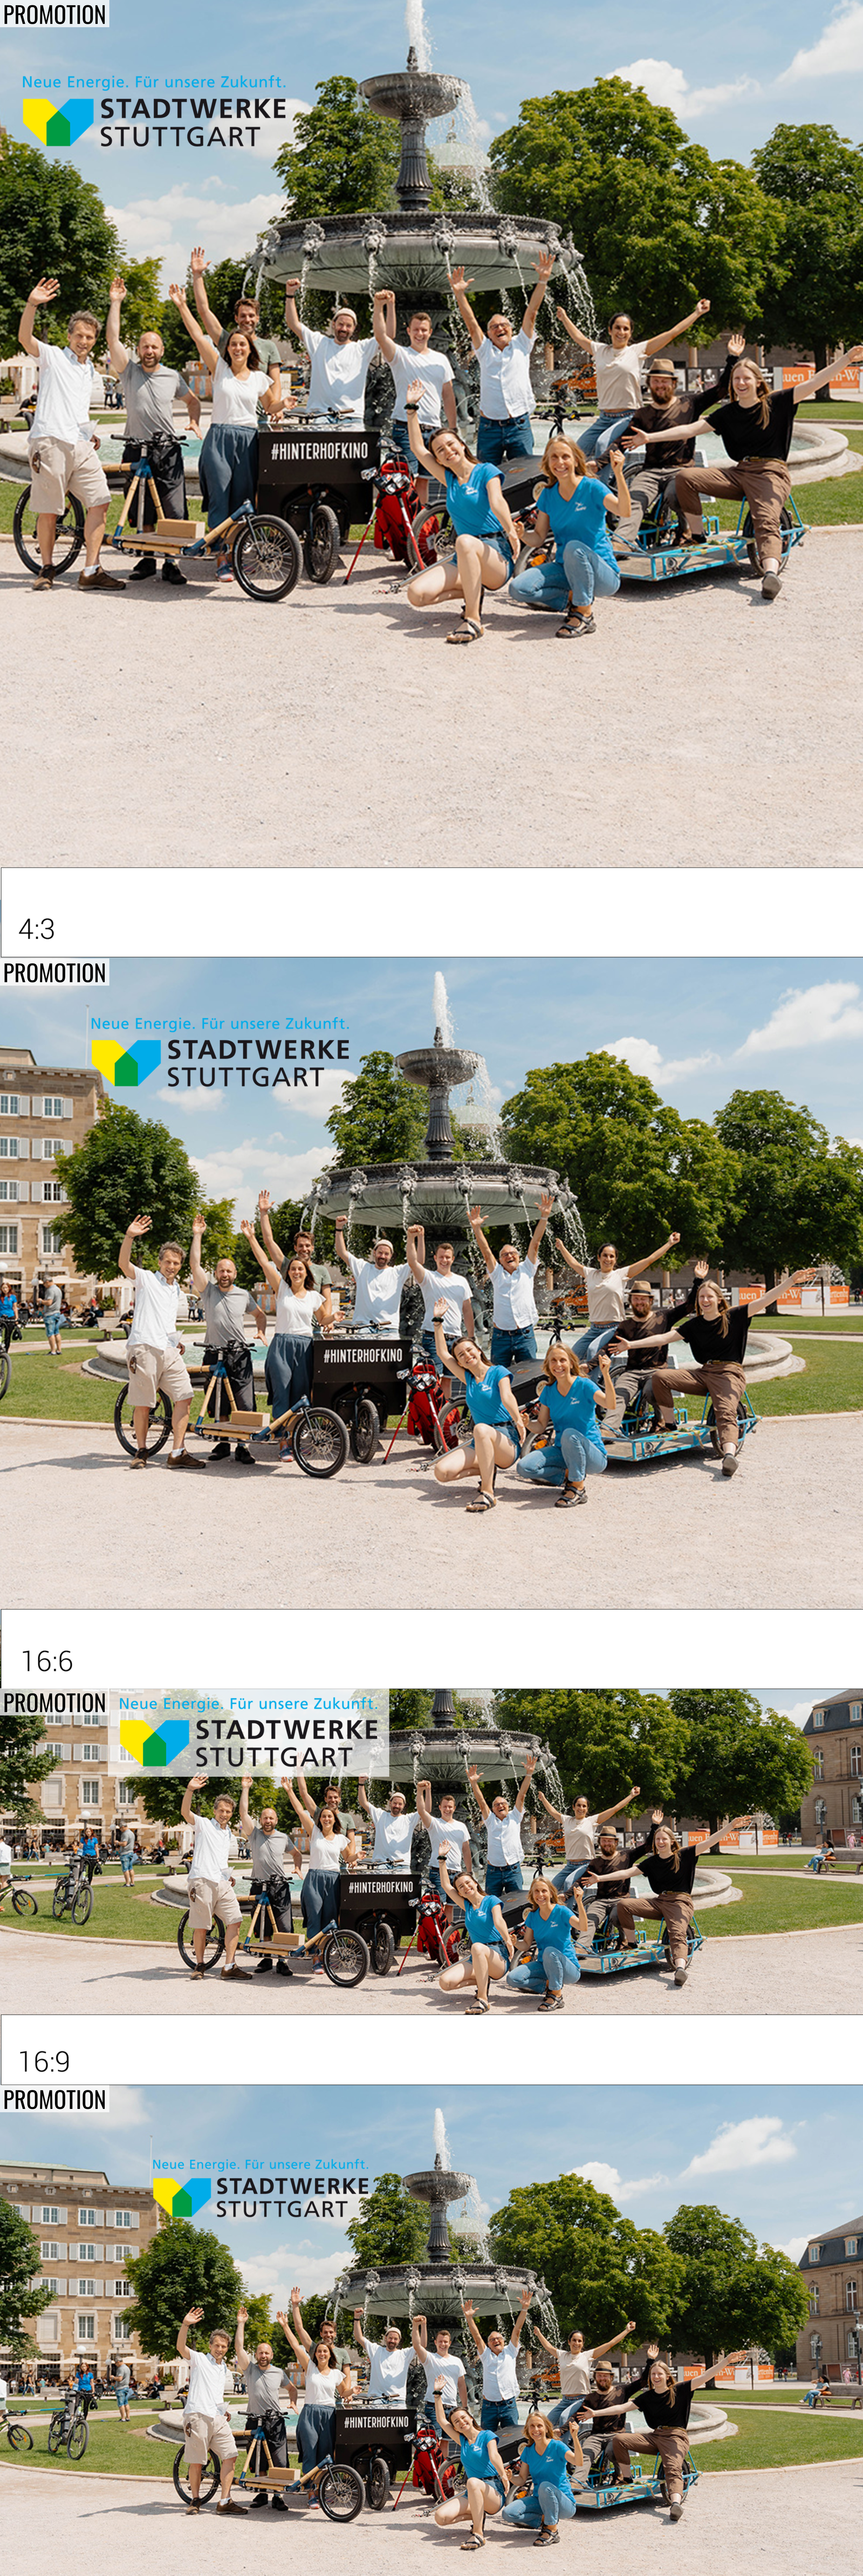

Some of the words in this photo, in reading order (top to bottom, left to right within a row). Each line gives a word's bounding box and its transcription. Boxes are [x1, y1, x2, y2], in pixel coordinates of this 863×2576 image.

[271, 442, 368, 460] #HINTERHOFKINO
[324, 1348, 402, 1363] #HINTERHOFKINO
[348, 1881, 413, 1894] #HINTERHOFKINO
[344, 2416, 409, 2428] #HINTERHOFKINO
